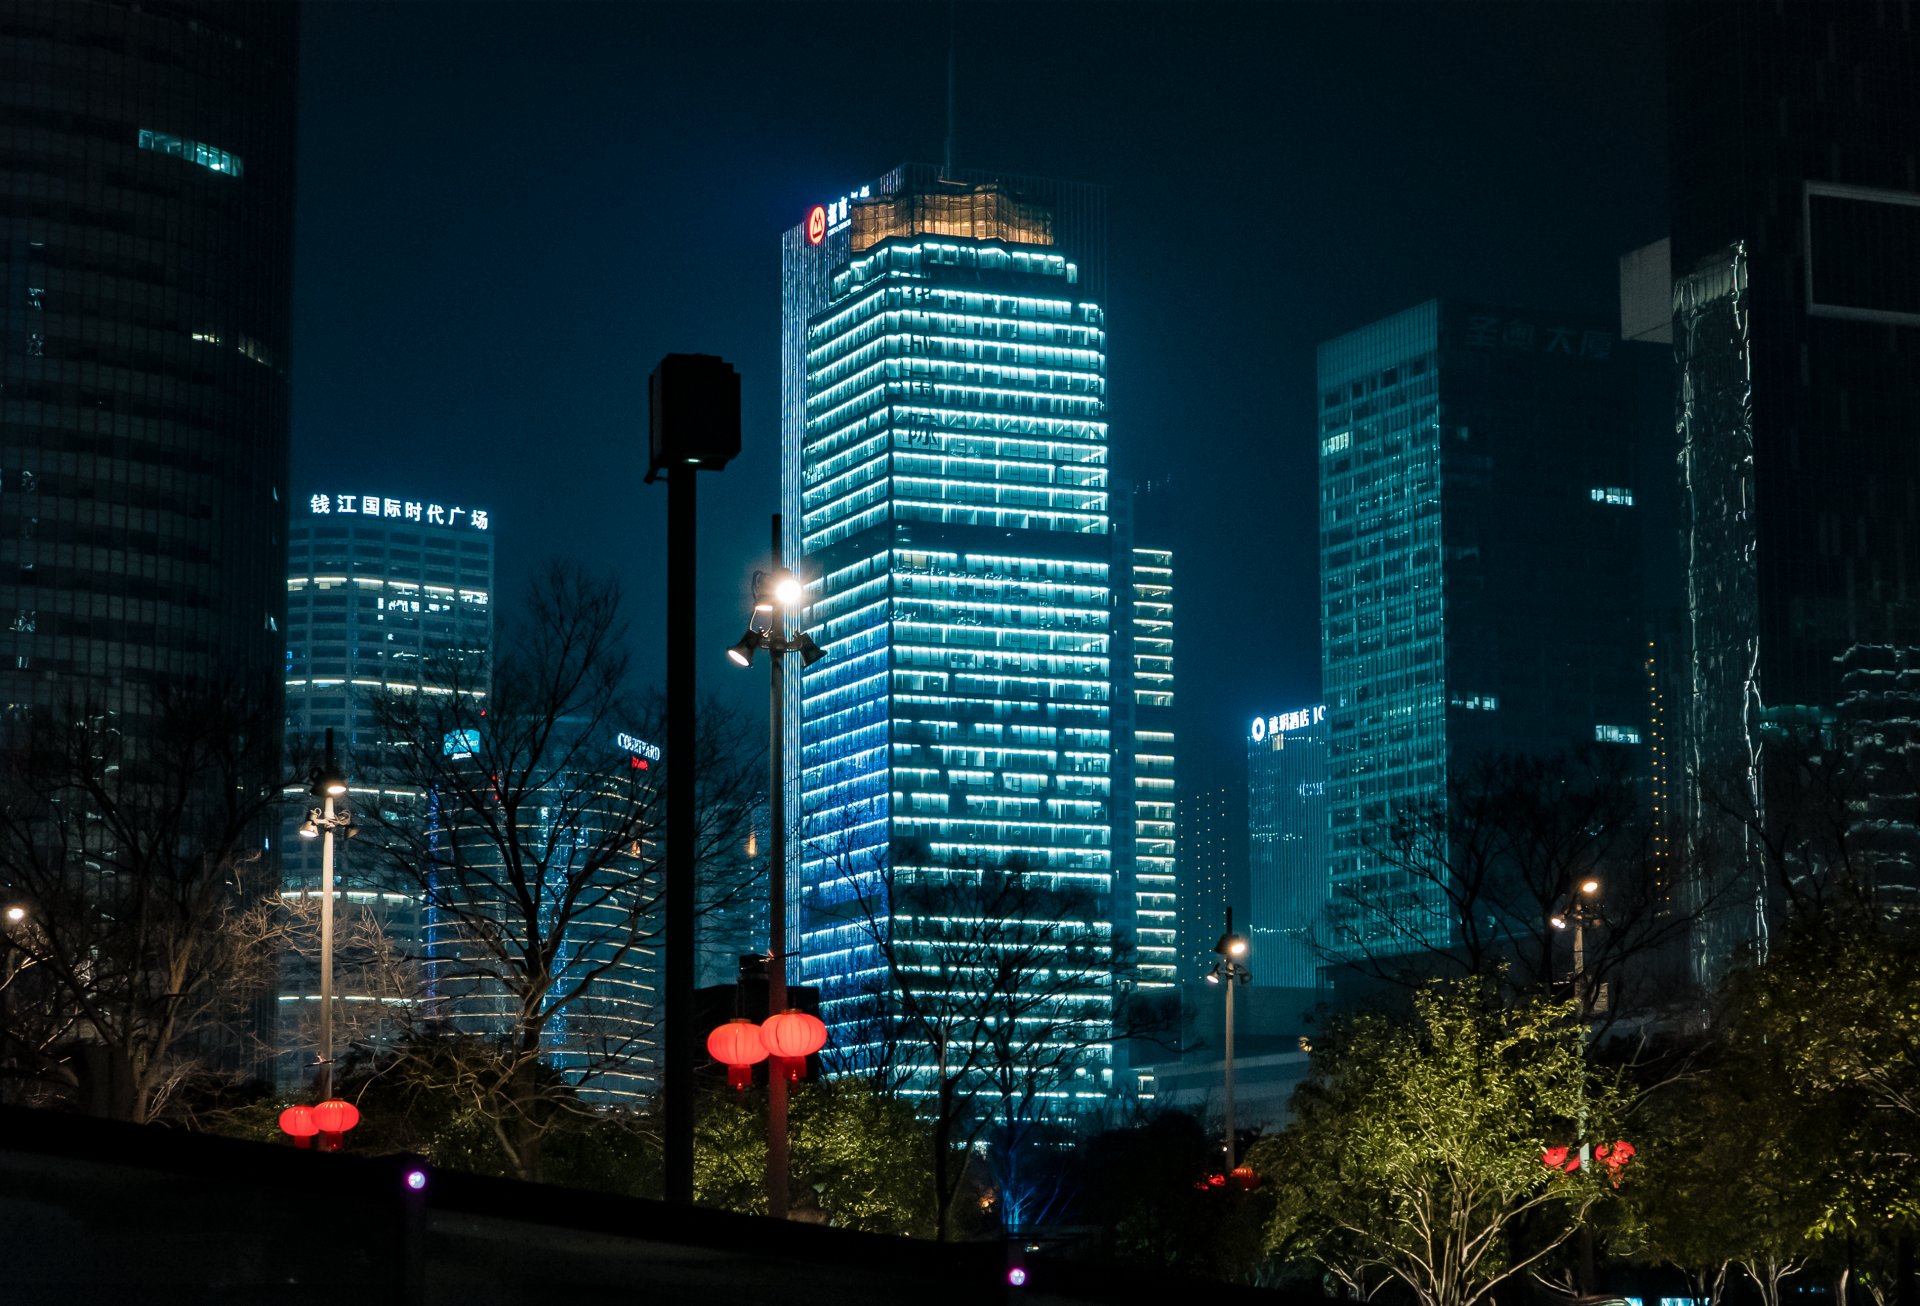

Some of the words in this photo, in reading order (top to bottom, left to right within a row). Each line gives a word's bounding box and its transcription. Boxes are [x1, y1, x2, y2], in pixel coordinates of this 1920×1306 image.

[310, 494, 489, 530] 钱江国际时代广场
